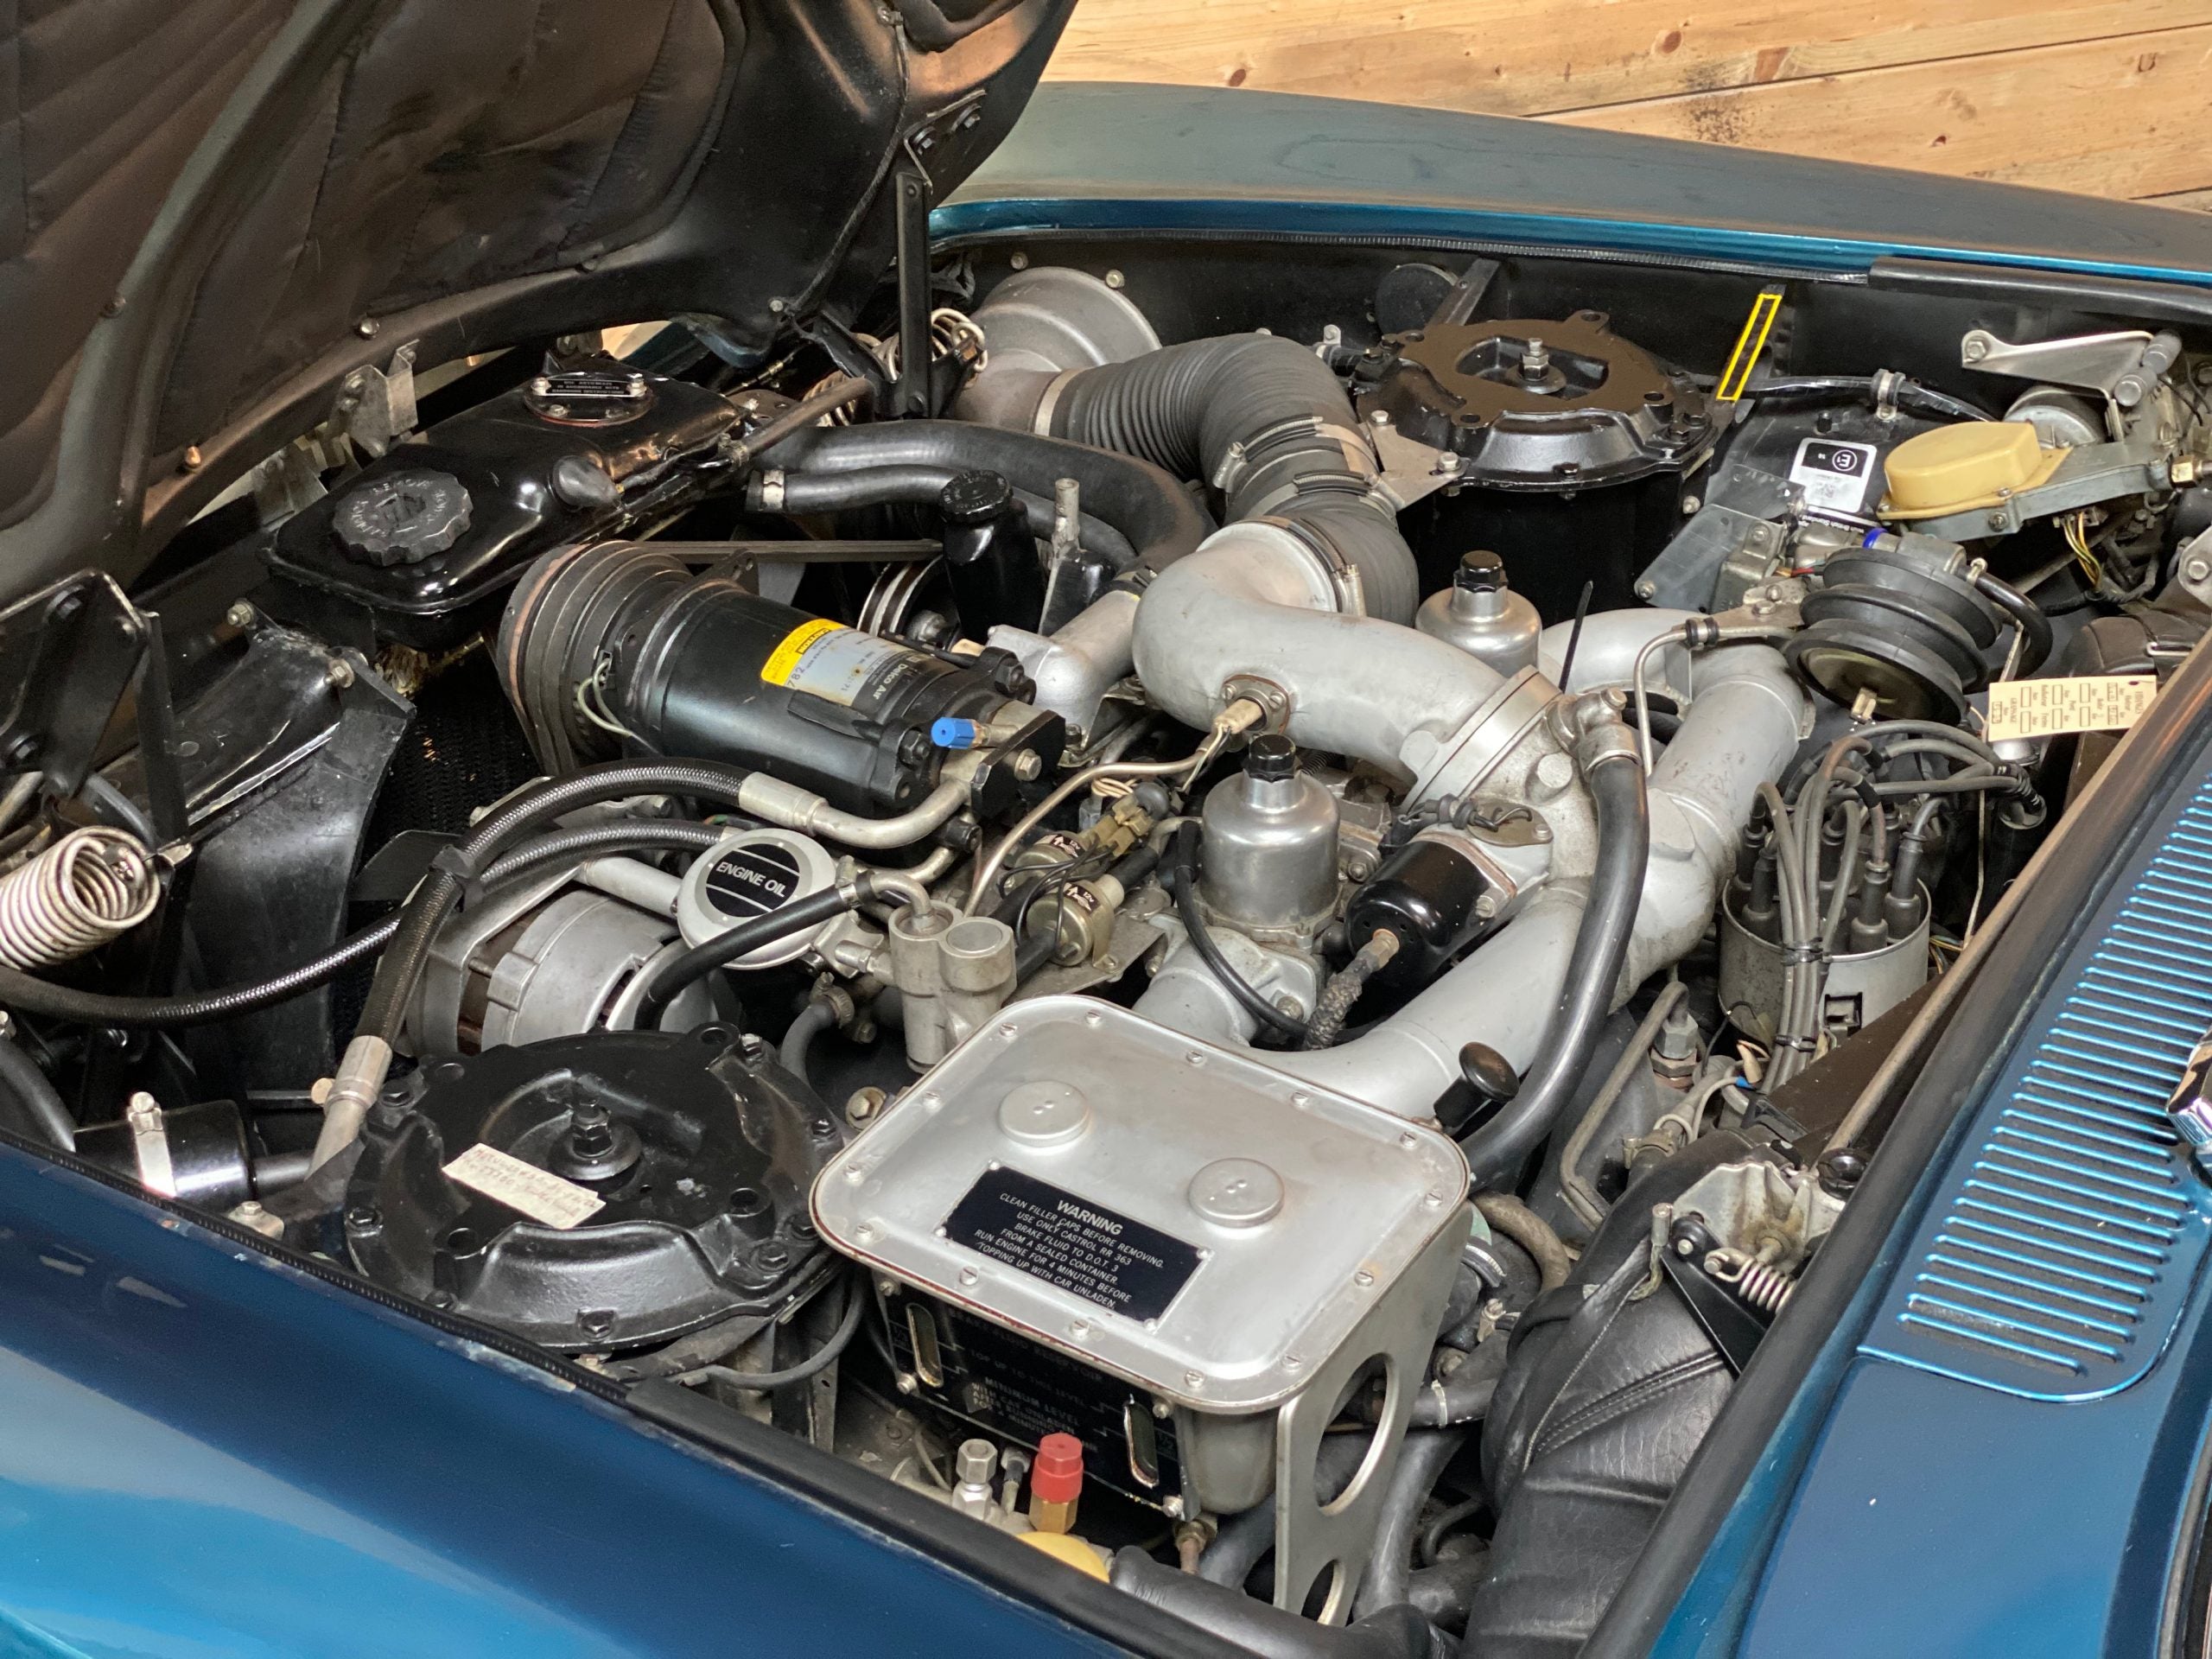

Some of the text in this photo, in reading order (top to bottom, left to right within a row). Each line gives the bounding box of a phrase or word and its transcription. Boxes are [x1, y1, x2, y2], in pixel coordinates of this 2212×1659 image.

[873, 683, 887, 700] Air
[884, 662, 908, 684] Delco
[715, 861, 787, 898] ENGINE OIL
[1001, 1193, 1163, 1268] CLEAN FILLER CAPS BEFORE REMOVING.
[1017, 1212, 1131, 1265] USE ONLY CASTROL RR 363
[1058, 1200, 1122, 1235] WARNING
[975, 1230, 994, 1242] RUN
[995, 1238, 1028, 1256] ENGINE
[1029, 1253, 1047, 1264] FOR
[1057, 1265, 1096, 1286] MINUTES
[1097, 1283, 1131, 1302] BEFORE
[1001, 1229, 1026, 1243] FROM
[1035, 1244, 1067, 1262] SEALED
[1070, 1259, 1117, 1283] CONTAINER.
[1014, 1223, 1043, 1238] BRAKE
[1044, 1236, 1070, 1250] FLUID
[1072, 1247, 1084, 1256] TO
[1085, 1254, 1109, 1266] D.O.T.
[979, 1243, 1014, 1262] TOPPING
[1031, 1266, 1052, 1279] WITH
[1054, 1276, 1071, 1287] CAR
[1073, 1285, 1116, 1309] UNLADEN.
